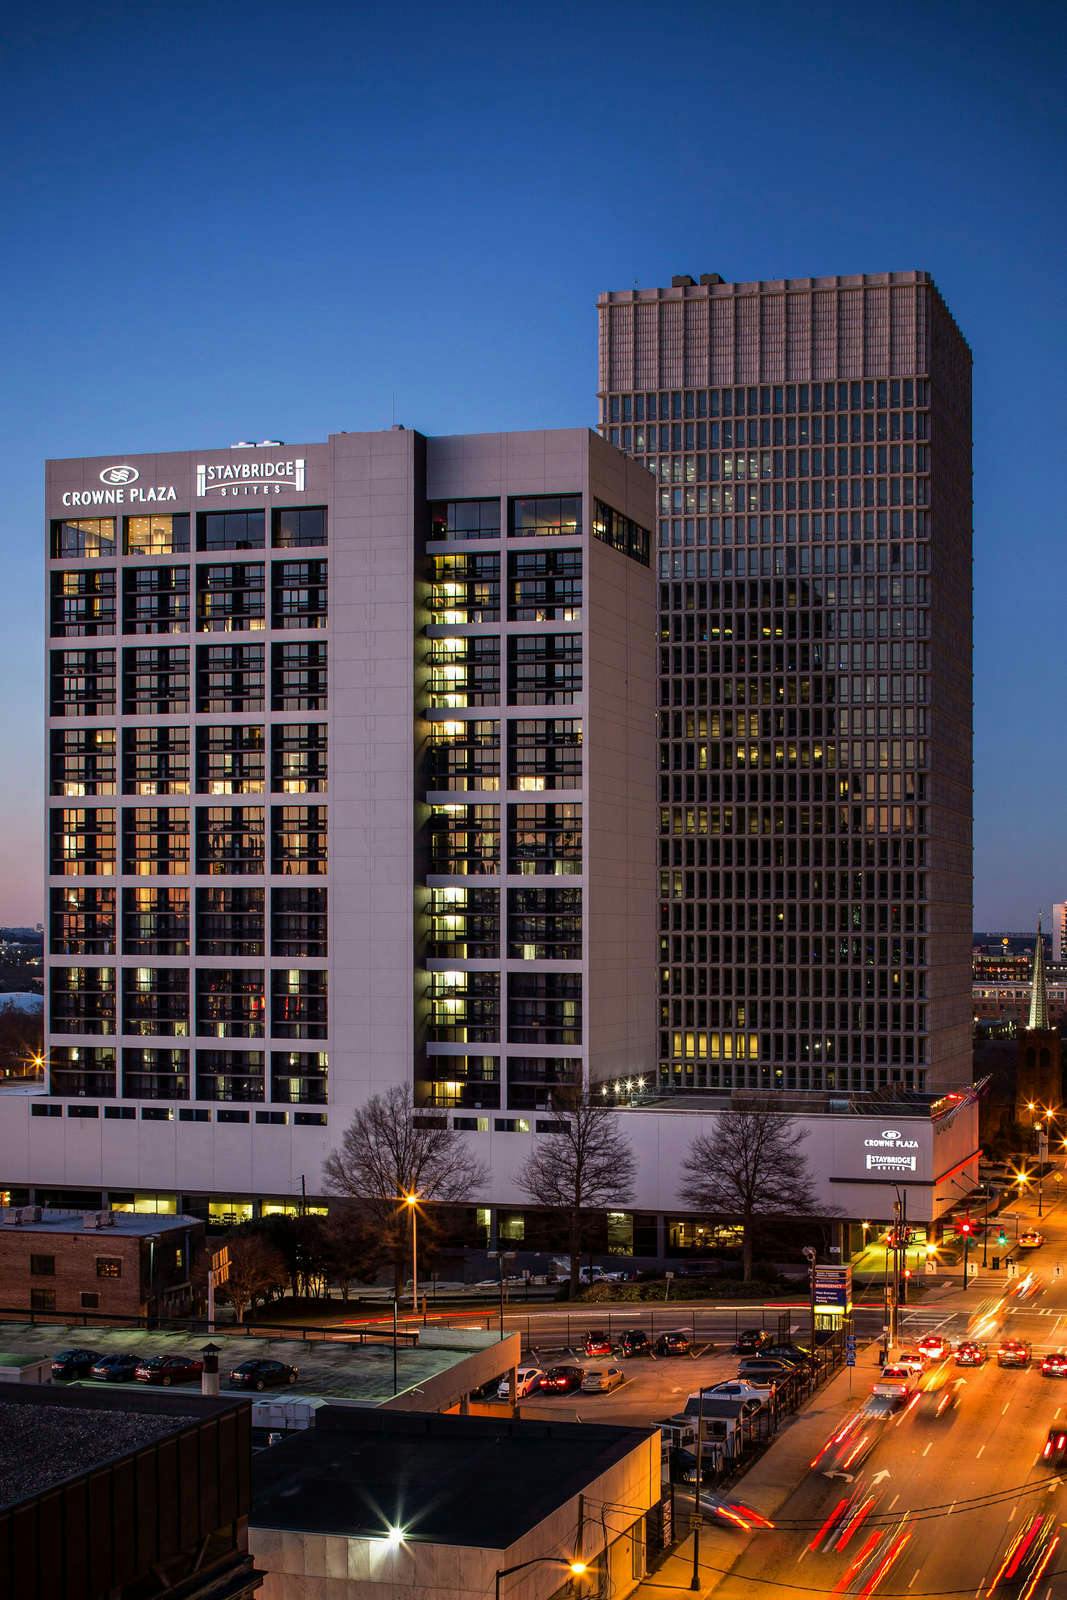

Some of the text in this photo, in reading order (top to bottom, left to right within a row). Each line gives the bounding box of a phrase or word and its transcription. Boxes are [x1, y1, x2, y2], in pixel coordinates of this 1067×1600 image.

[207, 461, 294, 480] STAYBRIDGE
[62, 486, 177, 506] CROWNE PLAZA
[221, 485, 281, 497] SUITES
[864, 1139, 919, 1148] CROWNE PLAZA
[871, 1155, 911, 1164] STAYBRIDGE
